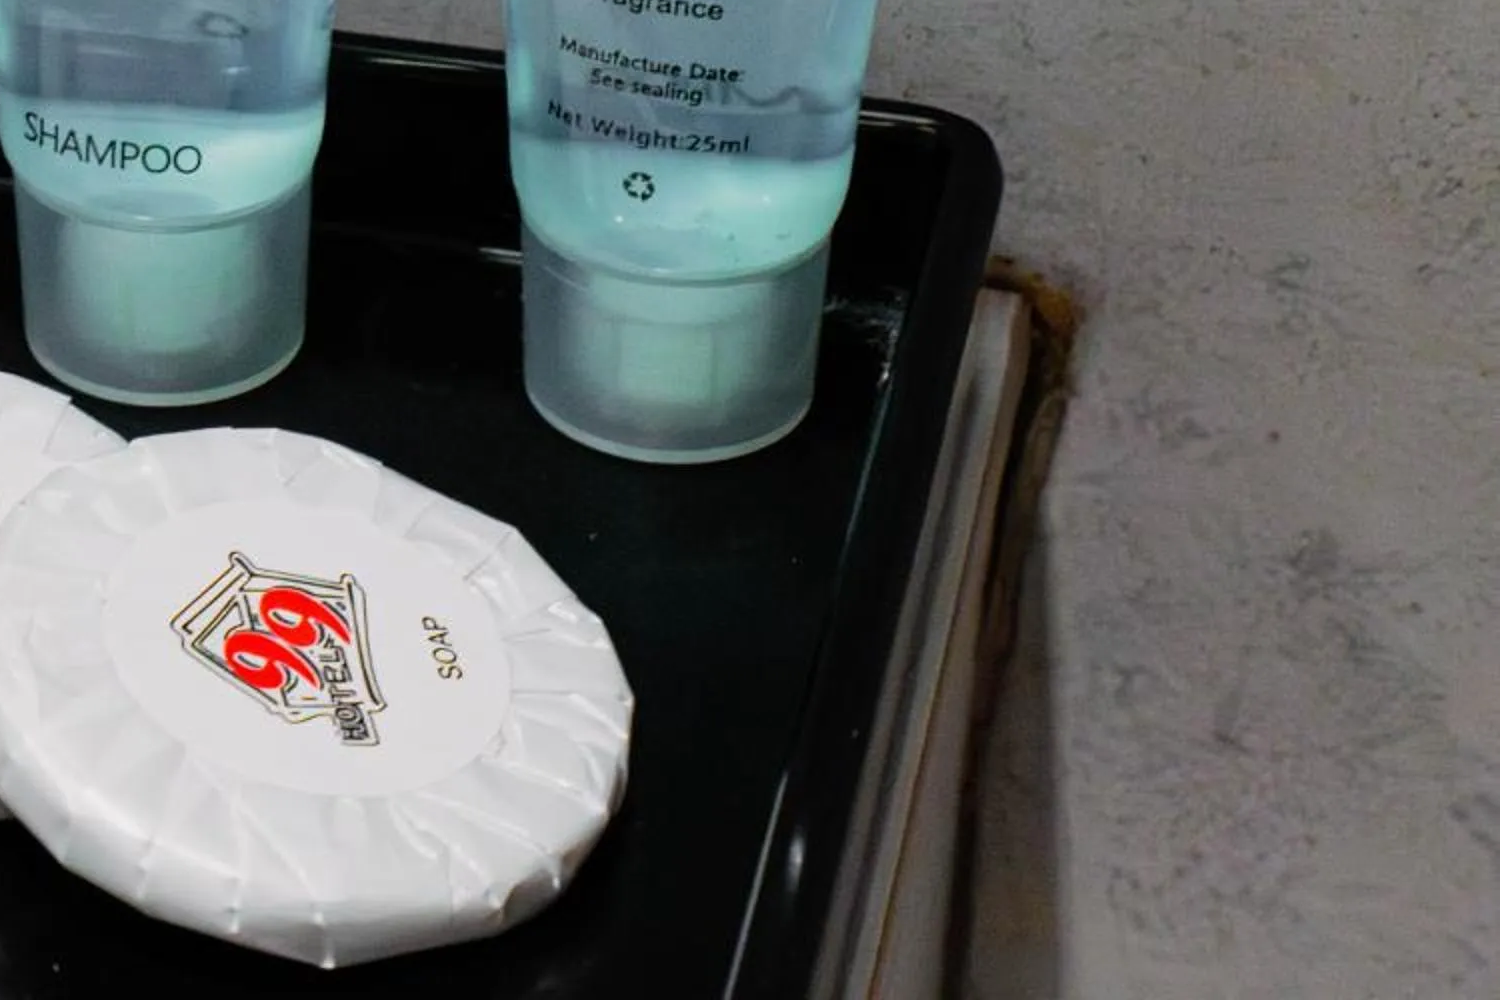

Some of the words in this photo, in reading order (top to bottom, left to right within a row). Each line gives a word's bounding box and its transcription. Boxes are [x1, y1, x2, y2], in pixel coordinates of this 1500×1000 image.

[560, 34, 683, 79] Manufacture
[590, 67, 625, 92] See
[632, 80, 704, 108] sealing
[23, 111, 203, 175] SHAMPOO
[547, 100, 582, 128] Net
[223, 585, 352, 690] 99
[421, 615, 463, 681] SOAP
[320, 644, 370, 743] HOTEL
